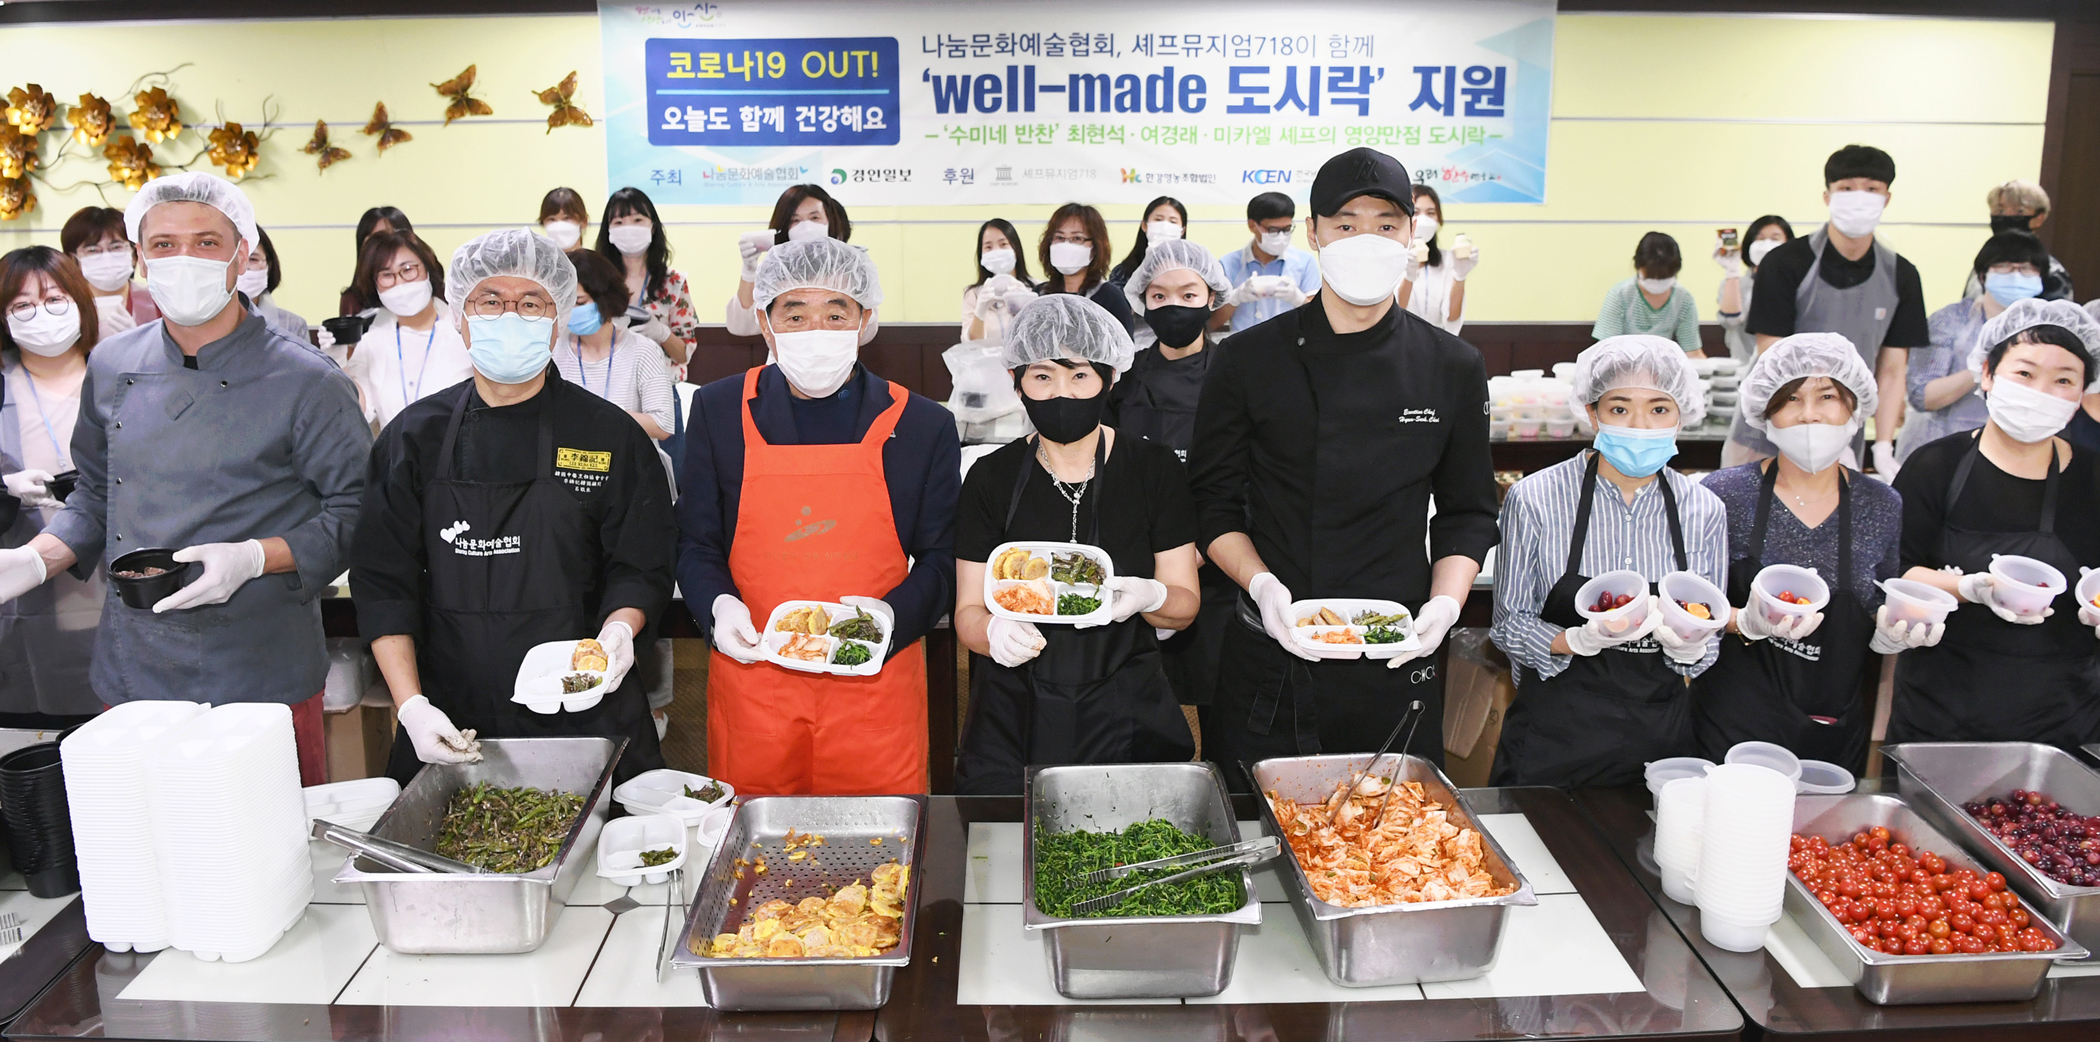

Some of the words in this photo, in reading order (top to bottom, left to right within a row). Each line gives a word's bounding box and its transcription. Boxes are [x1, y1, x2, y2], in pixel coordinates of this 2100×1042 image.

[923, 33, 1120, 60] 나눔문화예술협회,
[1131, 33, 1316, 59] 셰프뮤지엄718이
[1329, 34, 1374, 59] 함께
[666, 50, 786, 81] 코로나19
[801, 51, 878, 78] OUT!
[1408, 66, 1506, 118] 지원
[662, 106, 731, 132] 오늘도
[740, 106, 785, 132] 함께
[795, 106, 887, 133] 건강해요
[1280, 126, 1337, 146] 셰프의
[1345, 124, 1421, 146] 영양만점
[650, 169, 682, 186] 주최
[703, 165, 799, 181] 나눔문화예술협회
[851, 169, 912, 183] 경인일보
[942, 168, 974, 186] 후원
